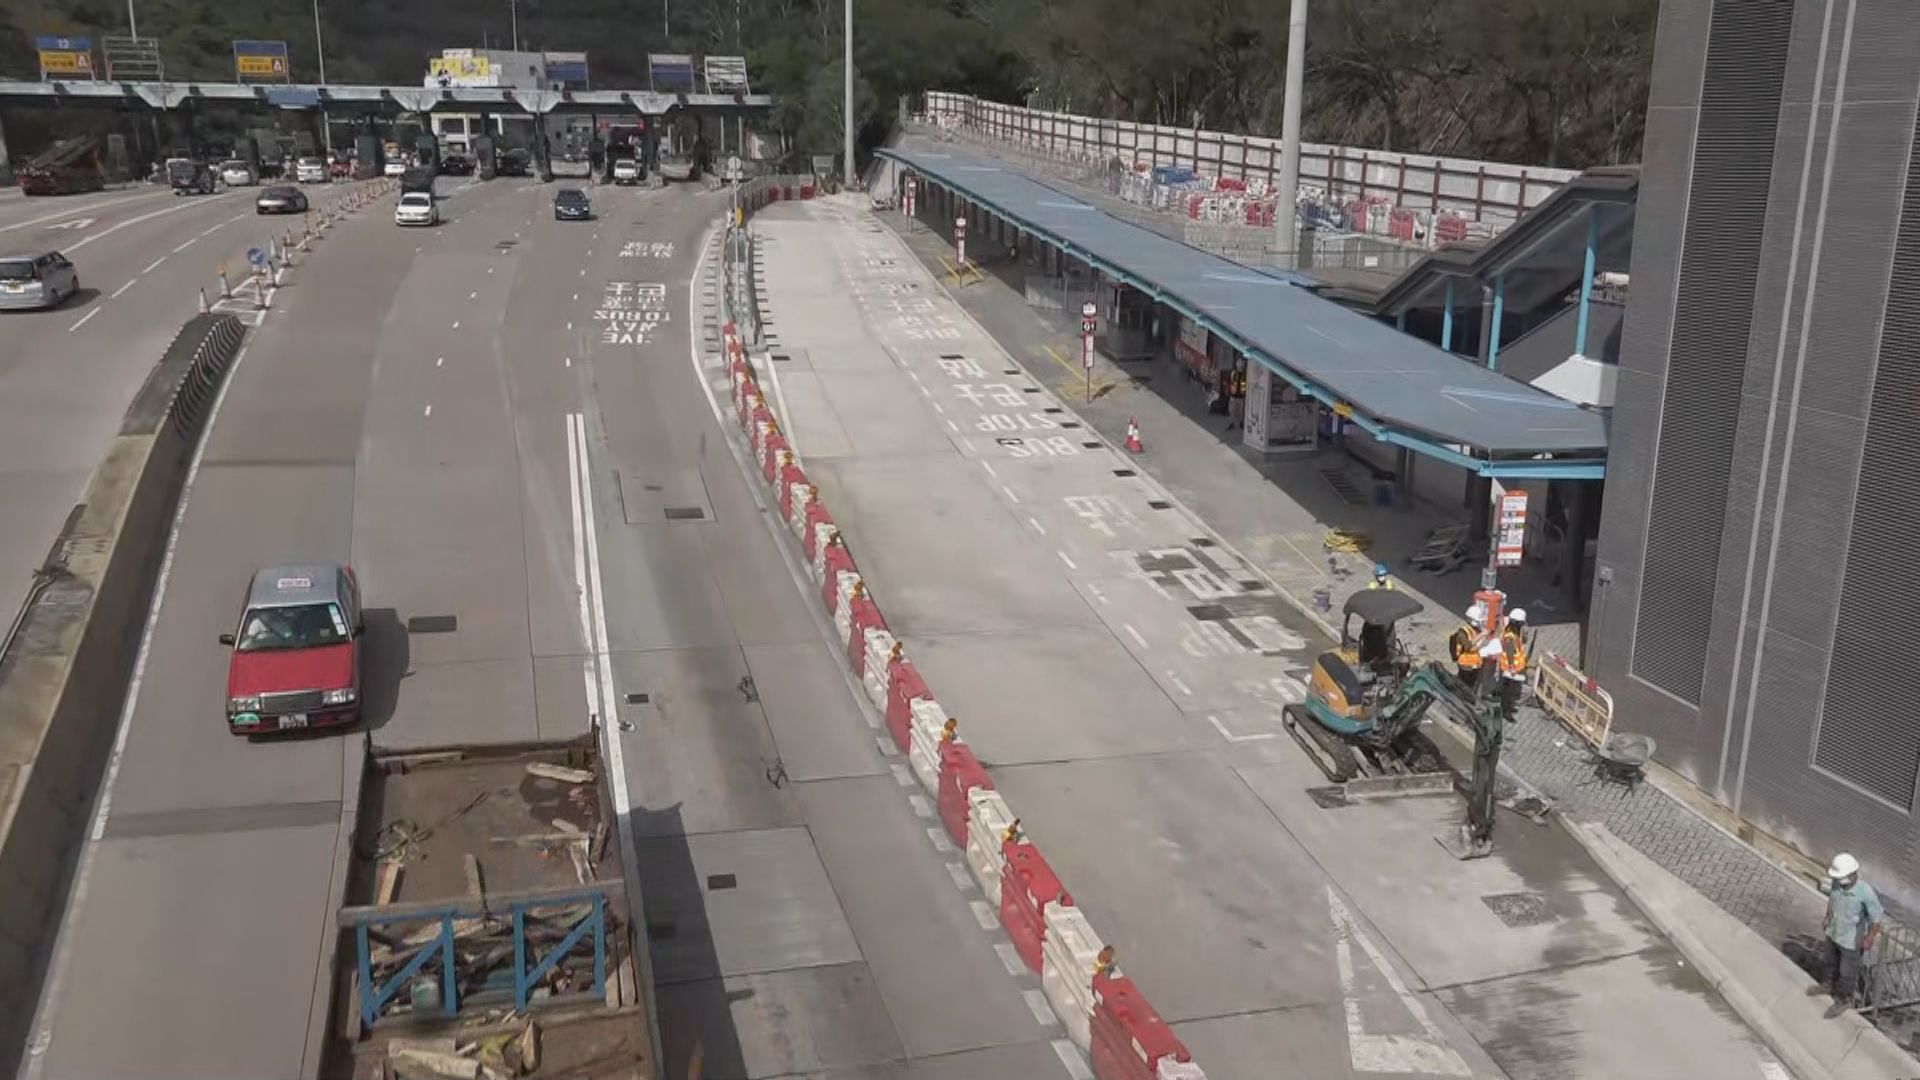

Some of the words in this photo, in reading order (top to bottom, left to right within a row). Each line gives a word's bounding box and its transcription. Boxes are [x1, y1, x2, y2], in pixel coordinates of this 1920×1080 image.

[952, 383, 1028, 408] 巴士
[975, 413, 1058, 432] STOP
[1002, 435, 1080, 458] BUS
